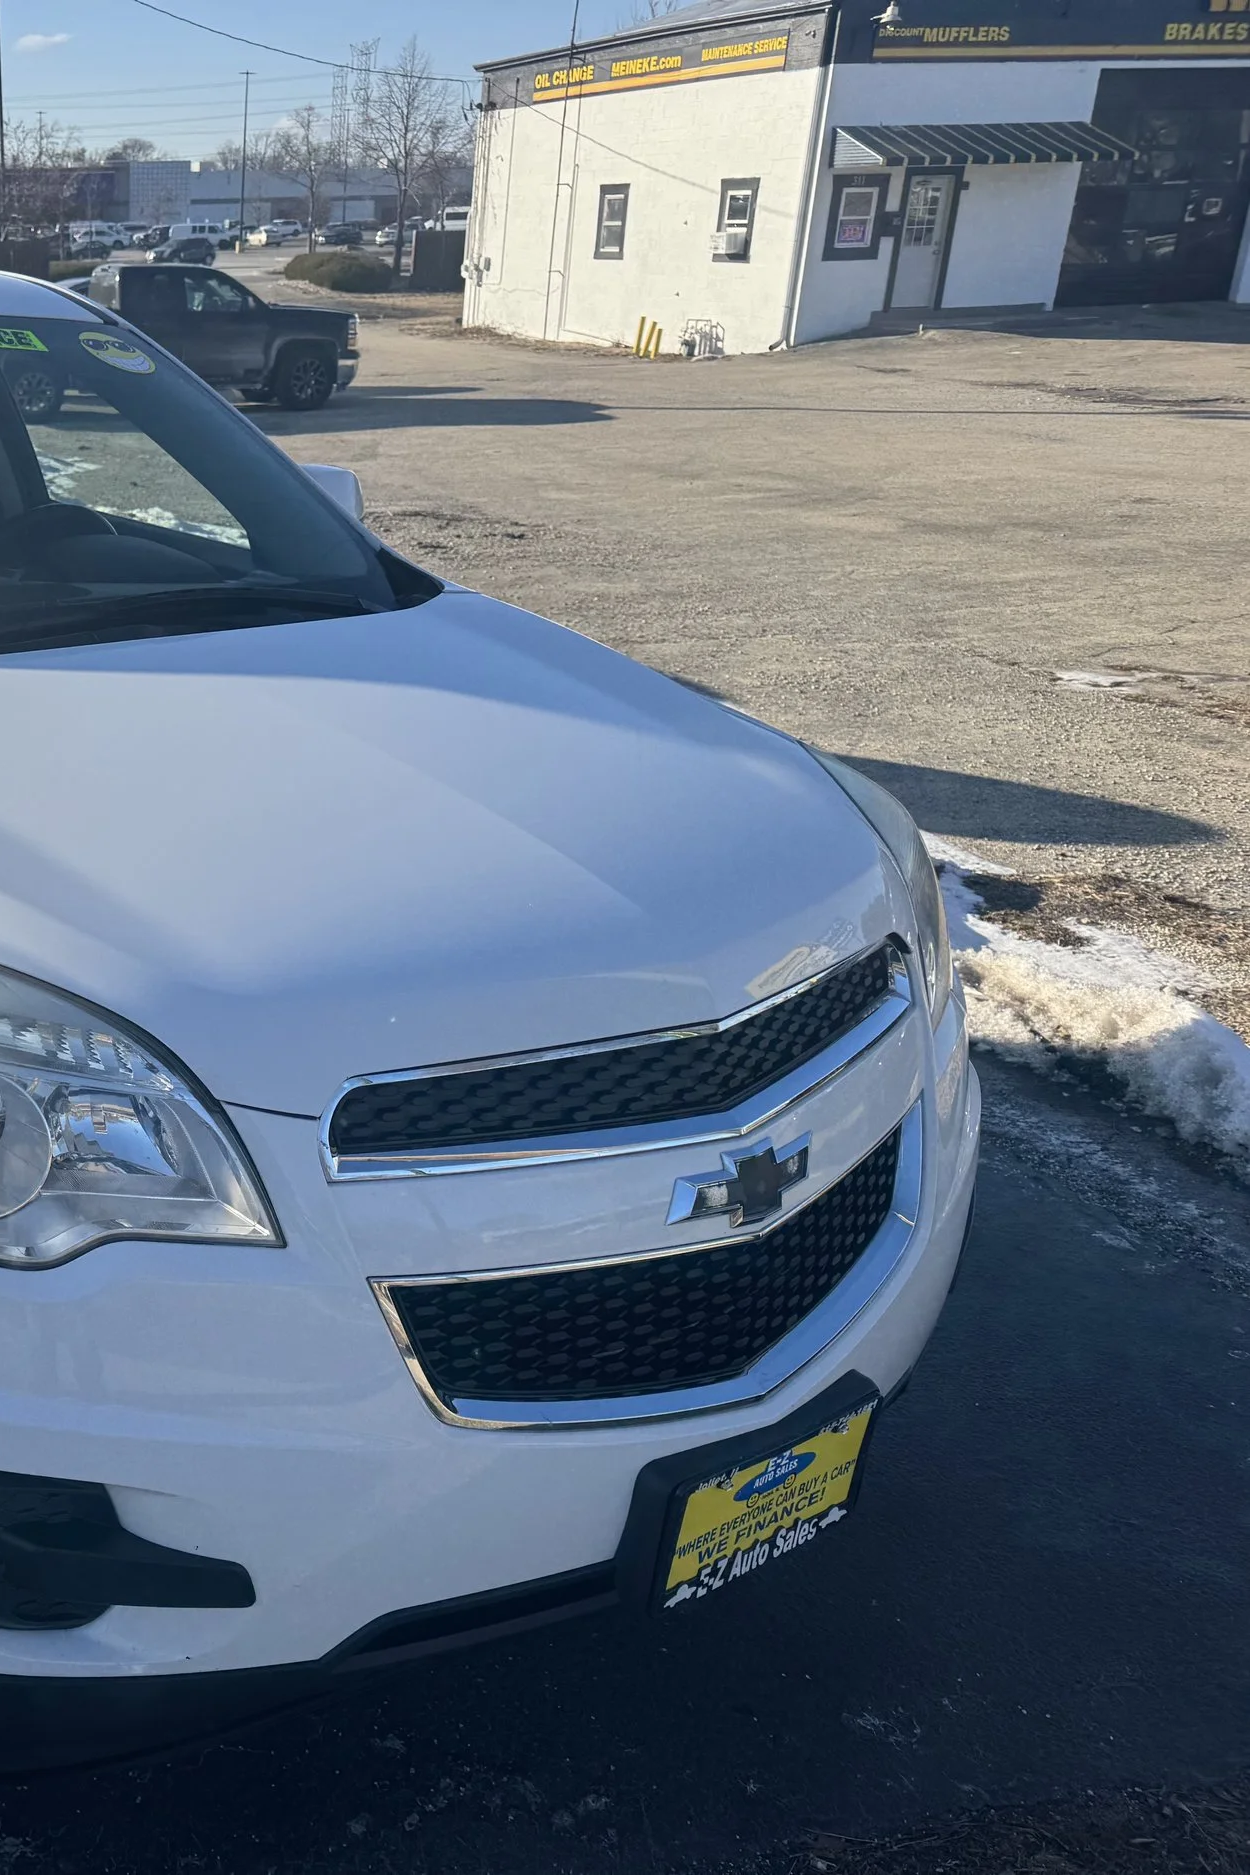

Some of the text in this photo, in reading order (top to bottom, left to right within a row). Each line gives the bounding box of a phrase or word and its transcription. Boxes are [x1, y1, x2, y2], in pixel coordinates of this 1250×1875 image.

[923, 26, 1011, 42] MUFFLERS
[1164, 22, 1249, 41] BRAKES
[701, 36, 789, 62] MAINTENANCE SERVICE
[534, 65, 595, 89] OIL CHANGE
[610, 54, 683, 78] MEINEKE.com
[767, 1449, 792, 1473] E-Z
[753, 1459, 799, 1489] AUTO SALES
[719, 1501, 775, 1538] EVERYONE
[775, 1488, 797, 1508] CAN
[797, 1479, 821, 1500] BUY
[818, 1471, 828, 1485] A
[697, 1487, 826, 1564] WE FINANCE!
[728, 1541, 769, 1584] Auto
[773, 1518, 819, 1559] Sales
